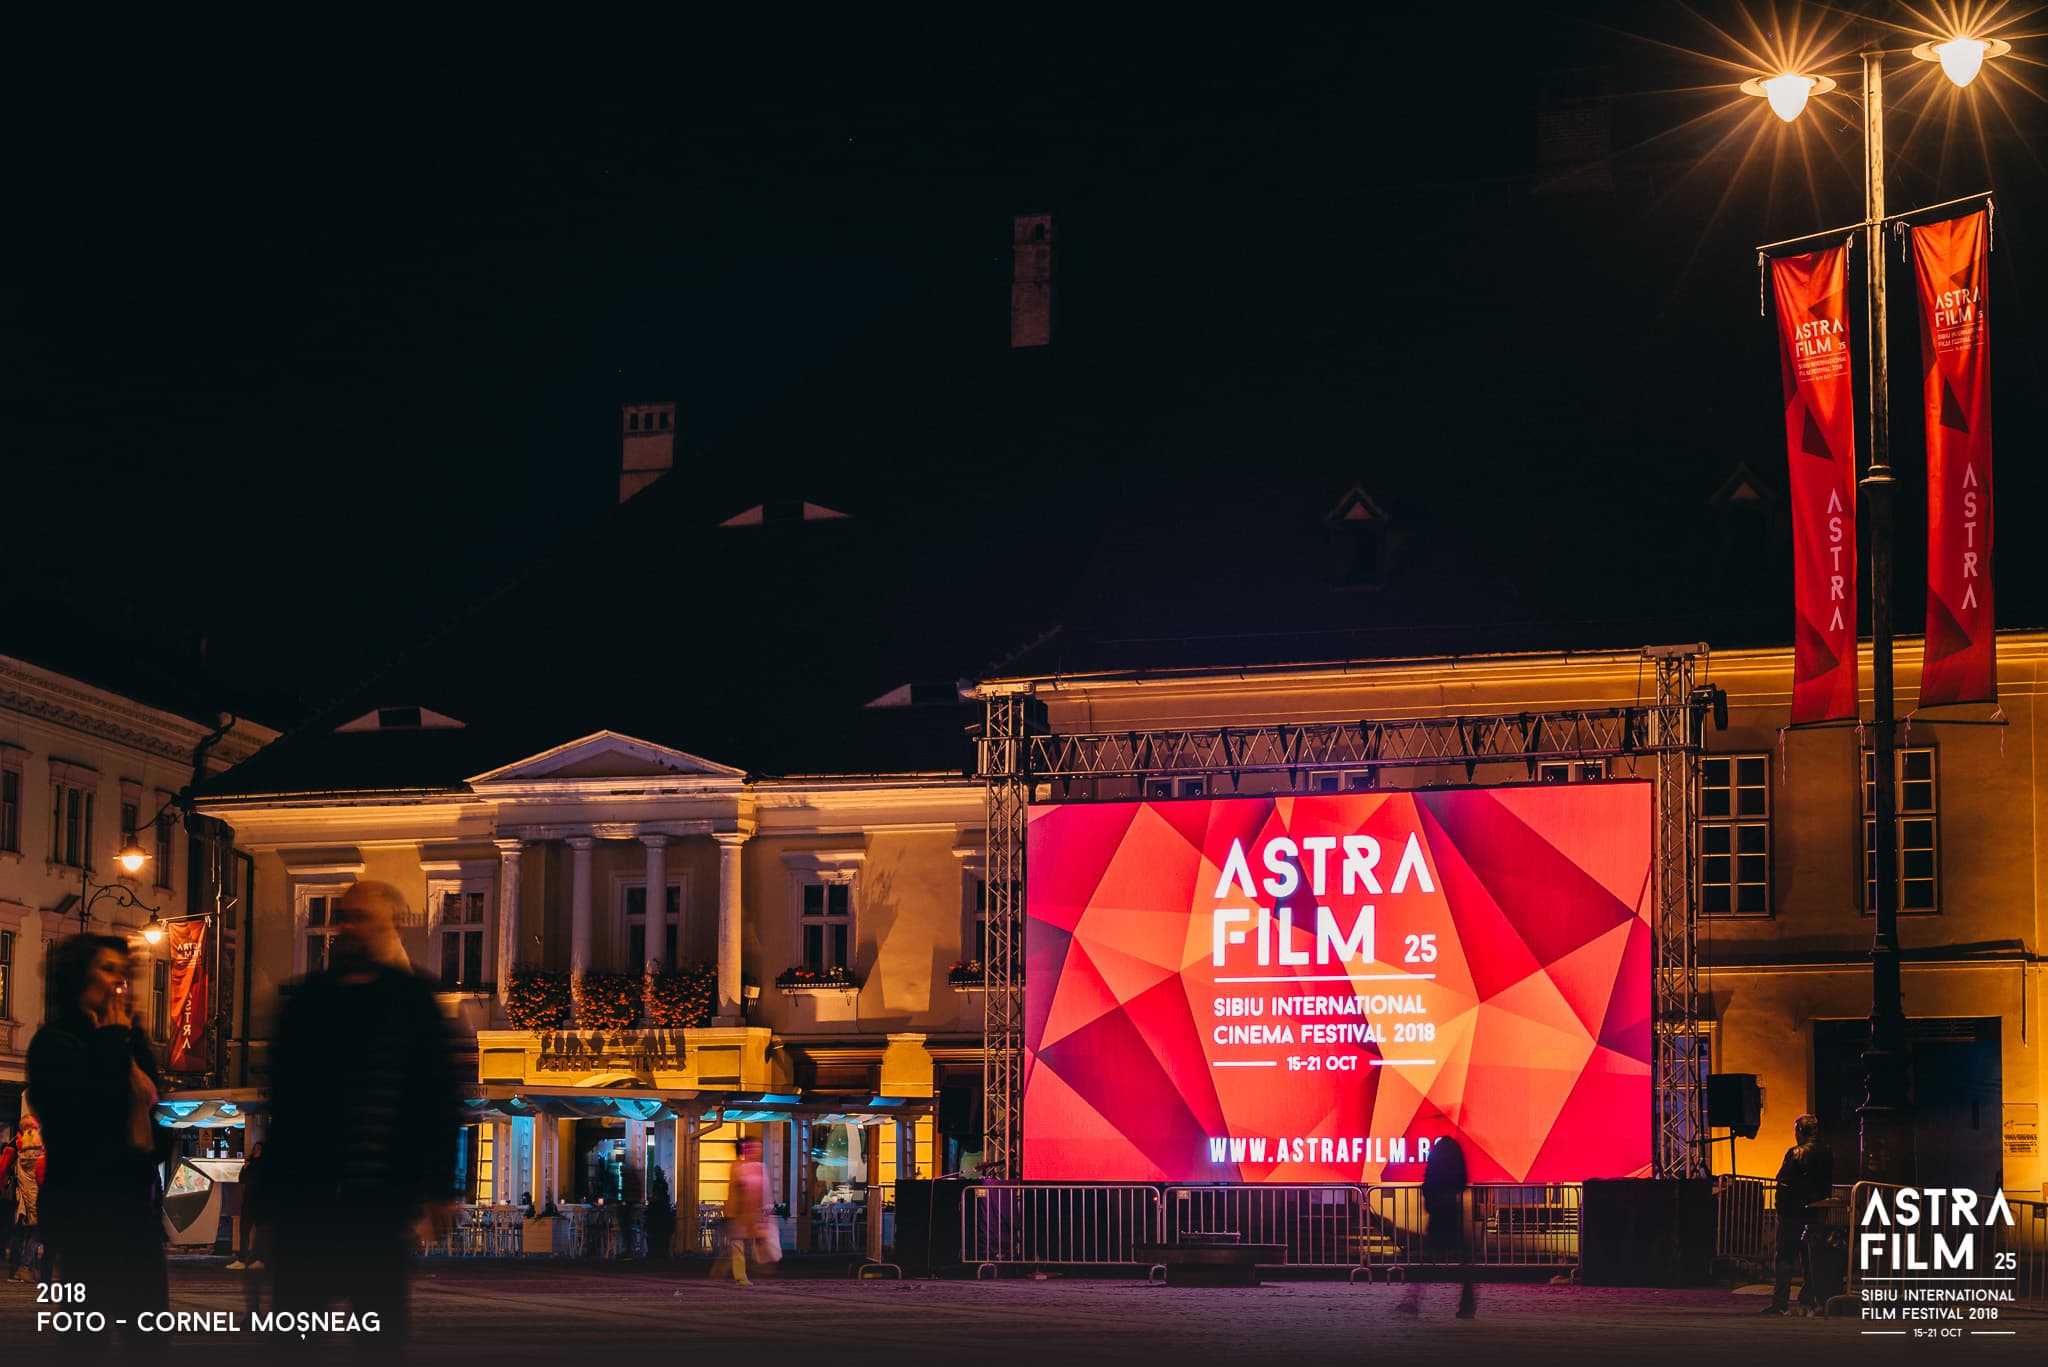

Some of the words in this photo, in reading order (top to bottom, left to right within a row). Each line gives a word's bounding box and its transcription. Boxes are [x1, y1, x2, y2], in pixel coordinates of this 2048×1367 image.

[1935, 285, 1981, 310] ASTRA
[1795, 316, 1844, 341] ASTRA
[1935, 305, 1972, 328] FILM
[1795, 336, 1832, 358] FILM
[1961, 461, 1978, 610] ASTRA
[1826, 487, 1845, 632] ASTRA
[1214, 832, 1435, 898] ASTRA
[1212, 905, 1375, 967] FILM
[1404, 934, 1438, 963] 25
[1213, 997, 1264, 1017] SIBIU
[1271, 995, 1427, 1016] INTERNATIONAL
[1213, 1025, 1294, 1045] CINEMA
[1301, 1023, 1387, 1043] FESTIVAL
[1393, 1022, 1436, 1043] 2018
[1287, 1056, 1321, 1071] 15-21
[1325, 1055, 1358, 1071] OCT
